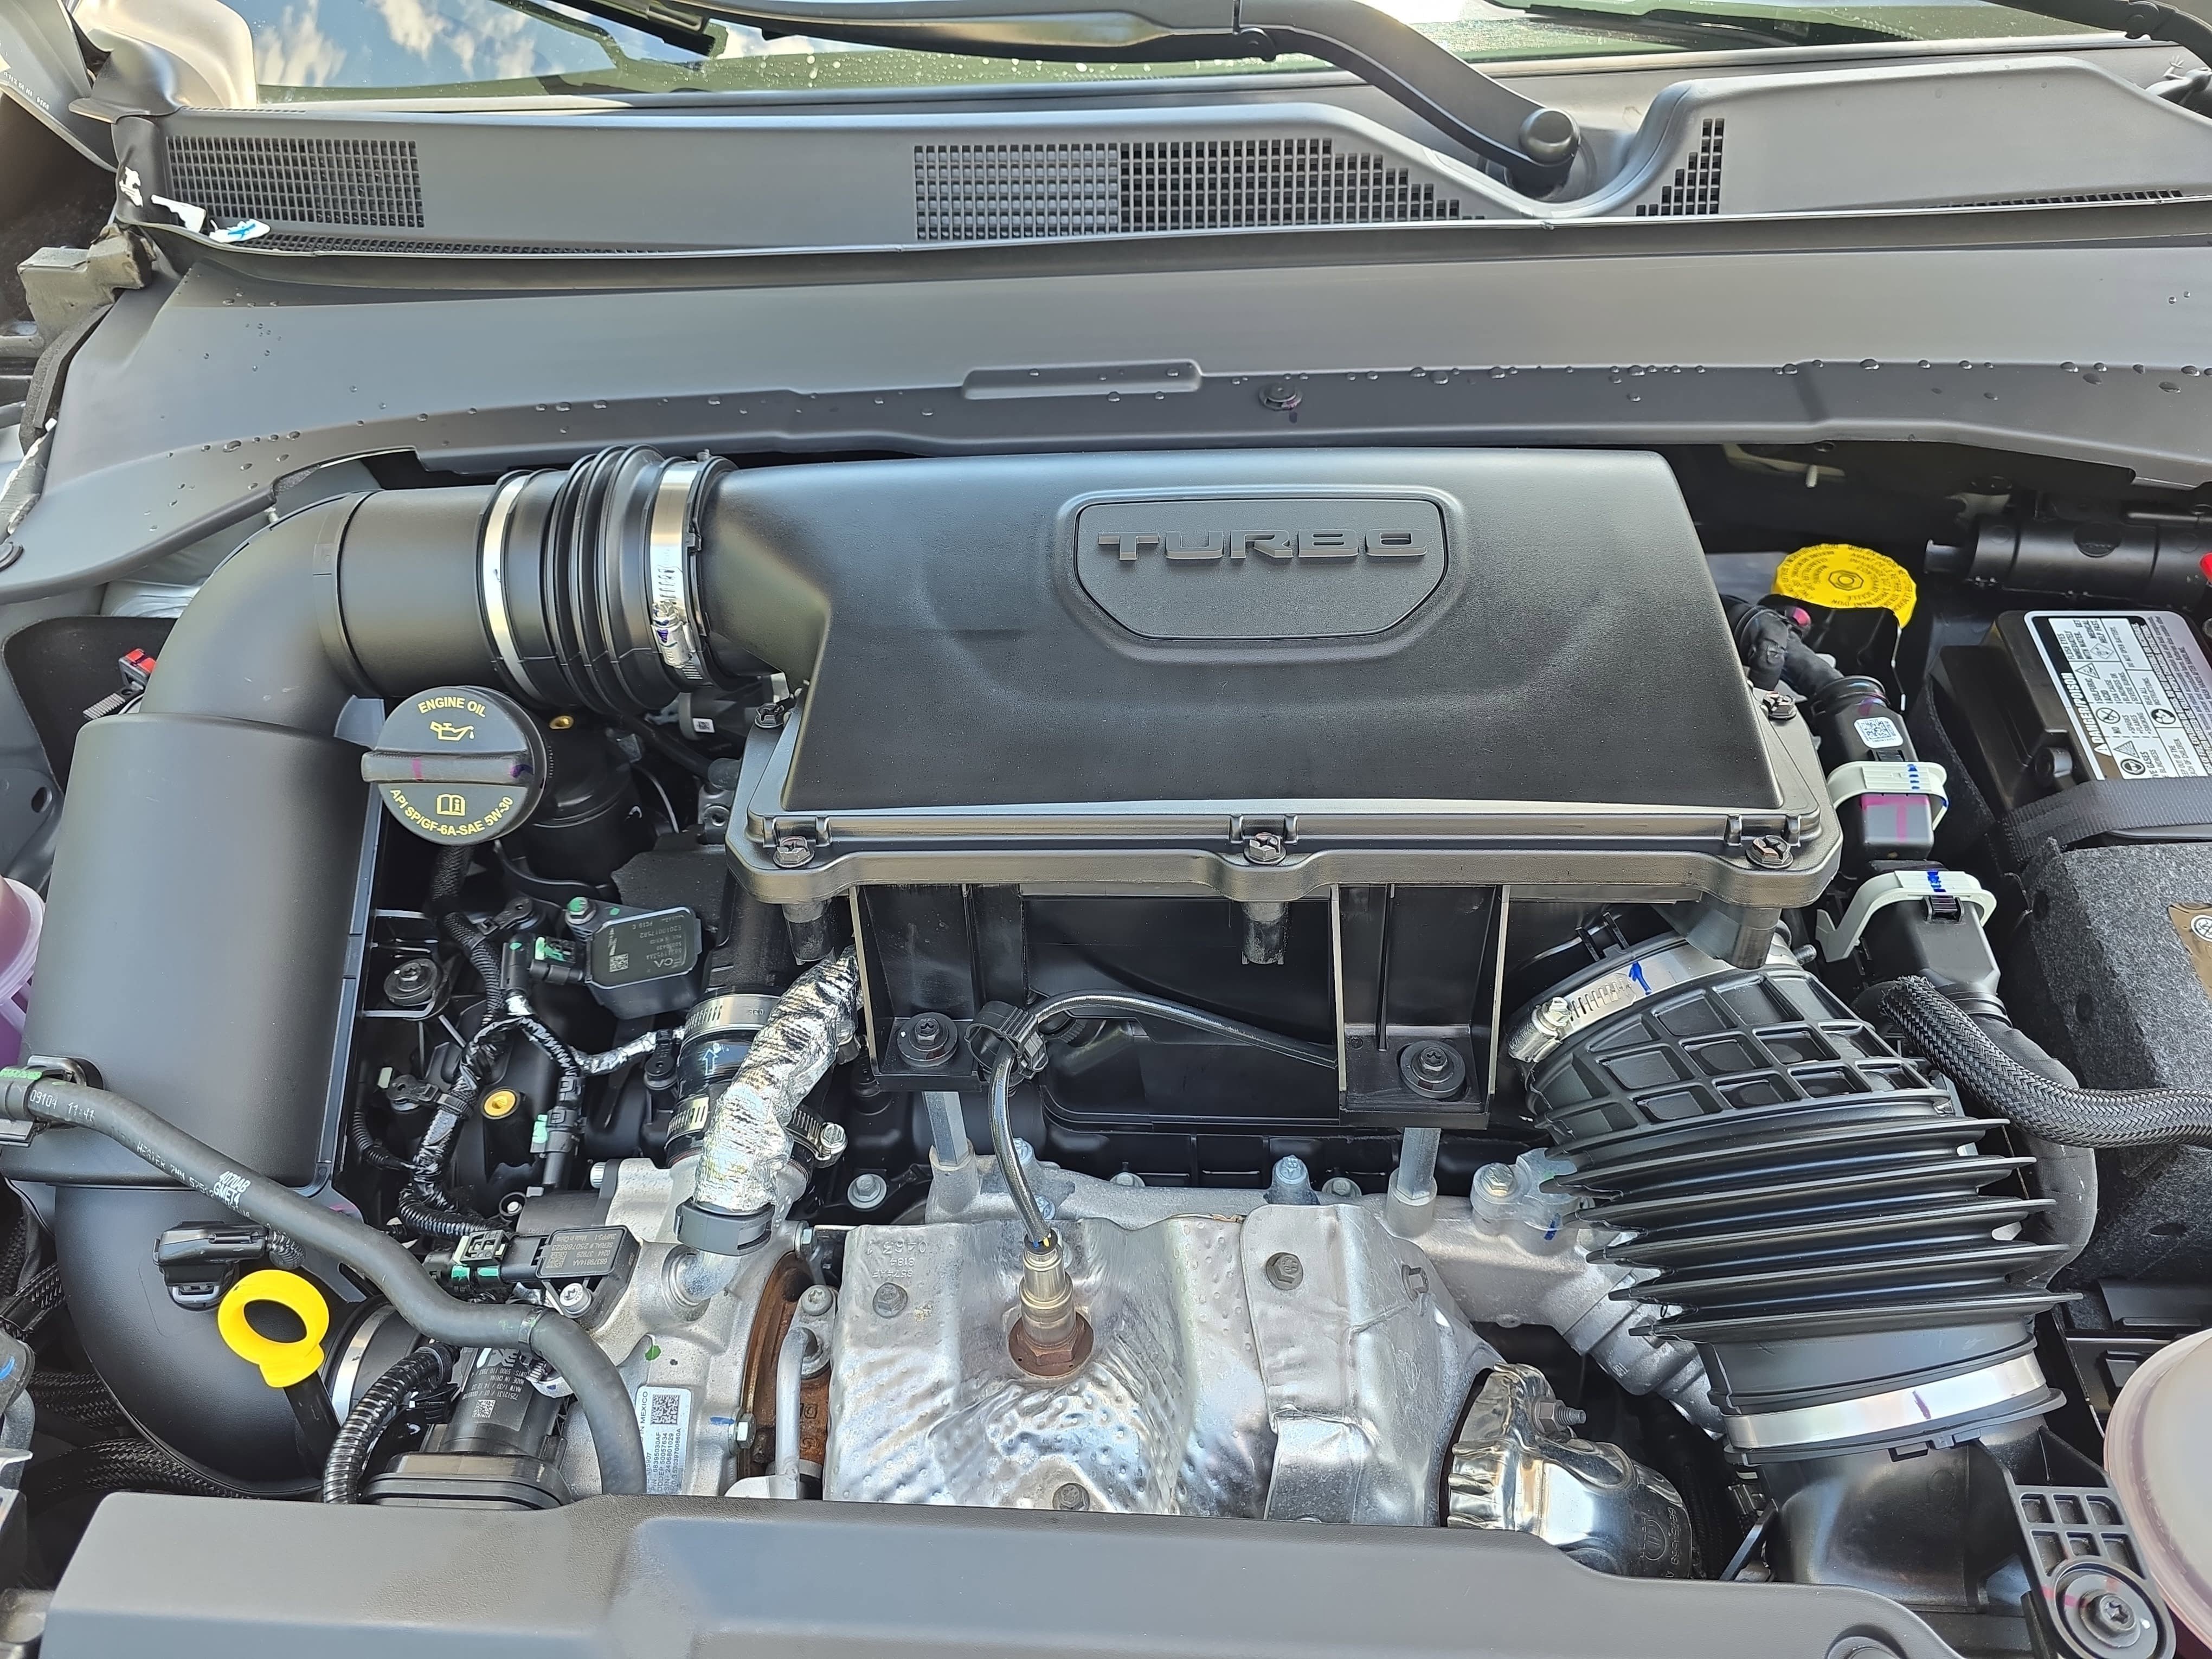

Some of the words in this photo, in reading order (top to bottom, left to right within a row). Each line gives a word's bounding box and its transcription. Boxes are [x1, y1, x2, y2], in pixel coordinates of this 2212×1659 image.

[1098, 529, 1427, 562] TURBO
[2056, 633, 2068, 644] EYES
[2081, 620, 2097, 638] MEDICAL
[2063, 630, 2084, 659] IMMEDIATELY
[2145, 653, 2167, 681] DISASSEMBLE
[2154, 654, 2172, 674] CHARGING
[2084, 678, 2102, 700] SULFURIC
[2103, 679, 2116, 692] CAUSE
[2112, 679, 2130, 701] BLINDNESS
[2160, 681, 2172, 690] NOT
[2165, 675, 2181, 691] PROPER
[2100, 689, 2112, 700] ACID
[2125, 686, 2138, 701] SEVERE
[2142, 695, 2153, 705] READ
[2174, 691, 2190, 709] FOLLOW
[418, 696, 465, 715] ENGINE
[467, 700, 486, 718] OIL
[2060, 672, 2105, 743] DANGER/POISON
[2180, 719, 2200, 744] EXPLOSION
[2188, 719, 2207, 740] INVERTED
[2139, 751, 2155, 768] GASES
[2148, 749, 2166, 773] BLINDNESS
[2175, 759, 2185, 768] OUT
[390, 788, 407, 810] API
[404, 805, 484, 837] SP/GF-6A-SAE
[484, 796, 514, 827] 5W-30
[30, 1089, 58, 1109] 09104
[219, 1171, 251, 1193] 4070AB
[665, 1433, 674, 1473] 2406801029
